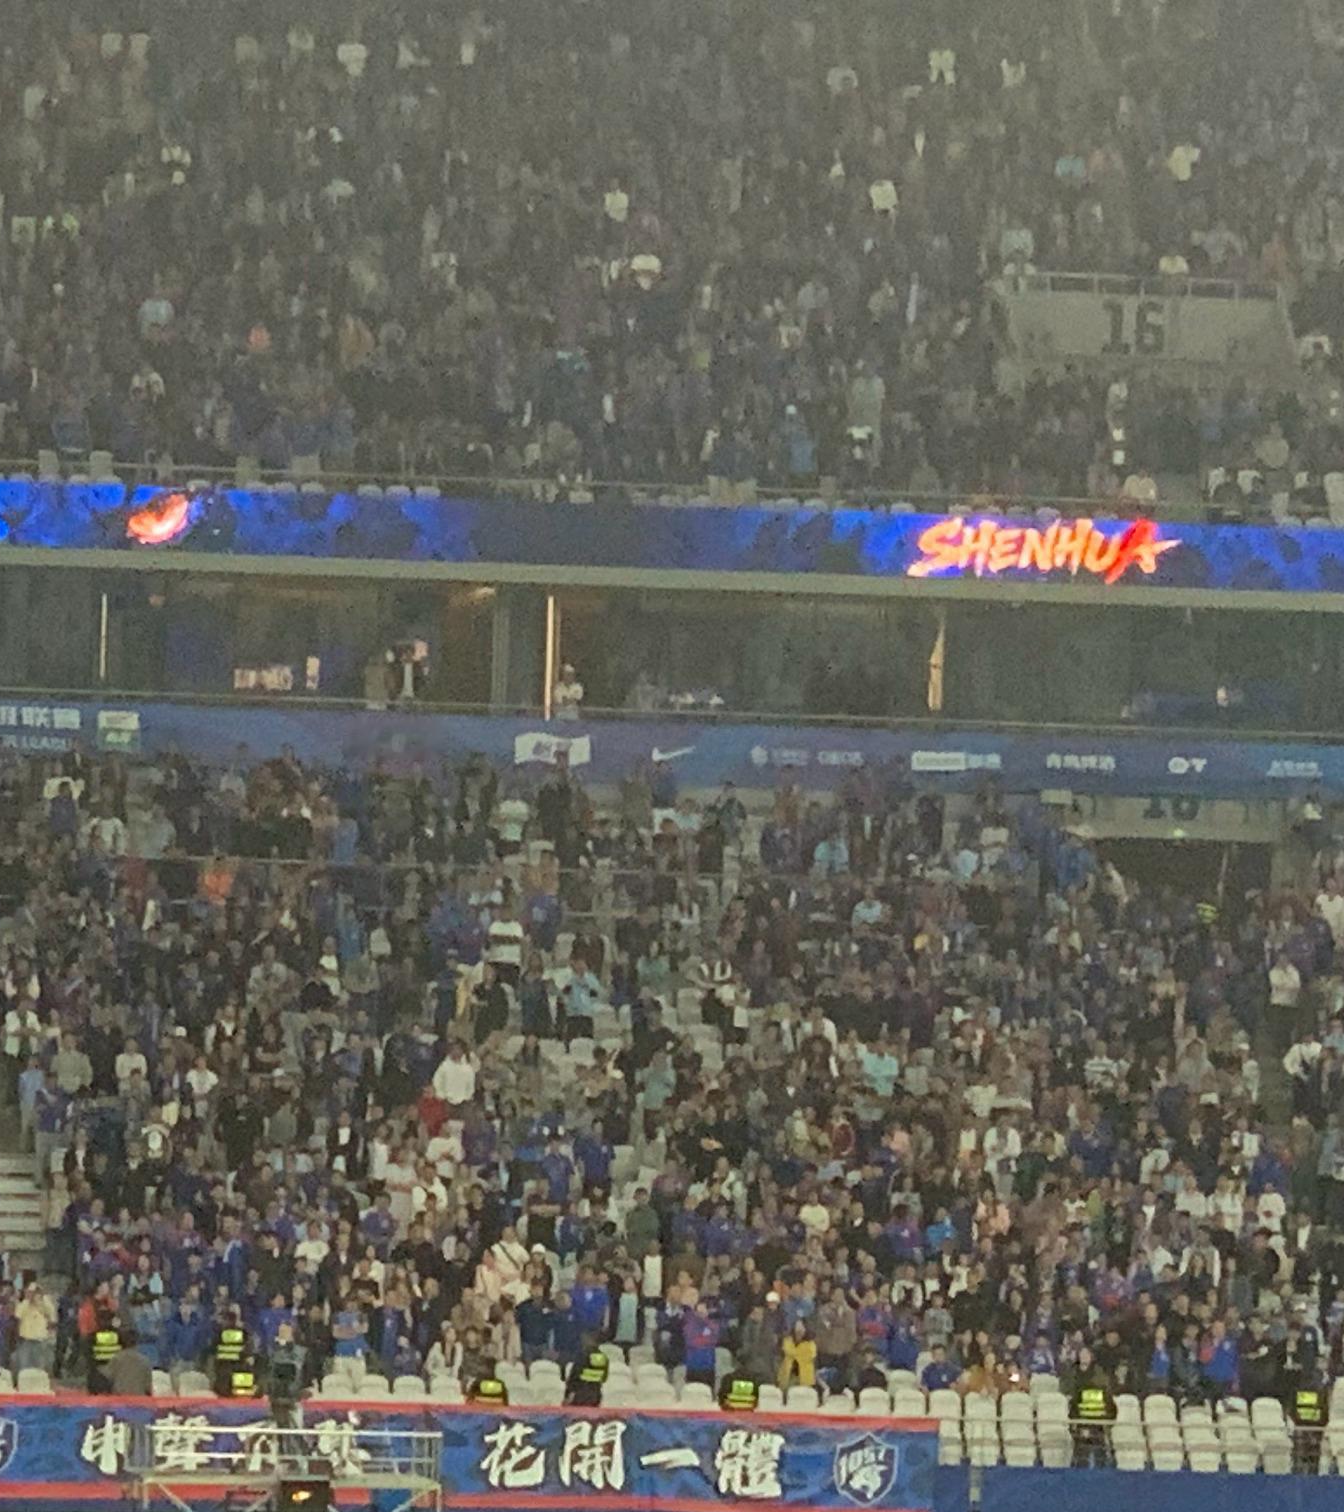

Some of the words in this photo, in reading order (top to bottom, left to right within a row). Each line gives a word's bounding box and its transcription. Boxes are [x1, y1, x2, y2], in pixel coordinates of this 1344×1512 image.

[1102, 301, 1165, 353] 16
[907, 515, 1182, 584] SHENHUA
[480, 1420, 786, 1499] 花開一體
